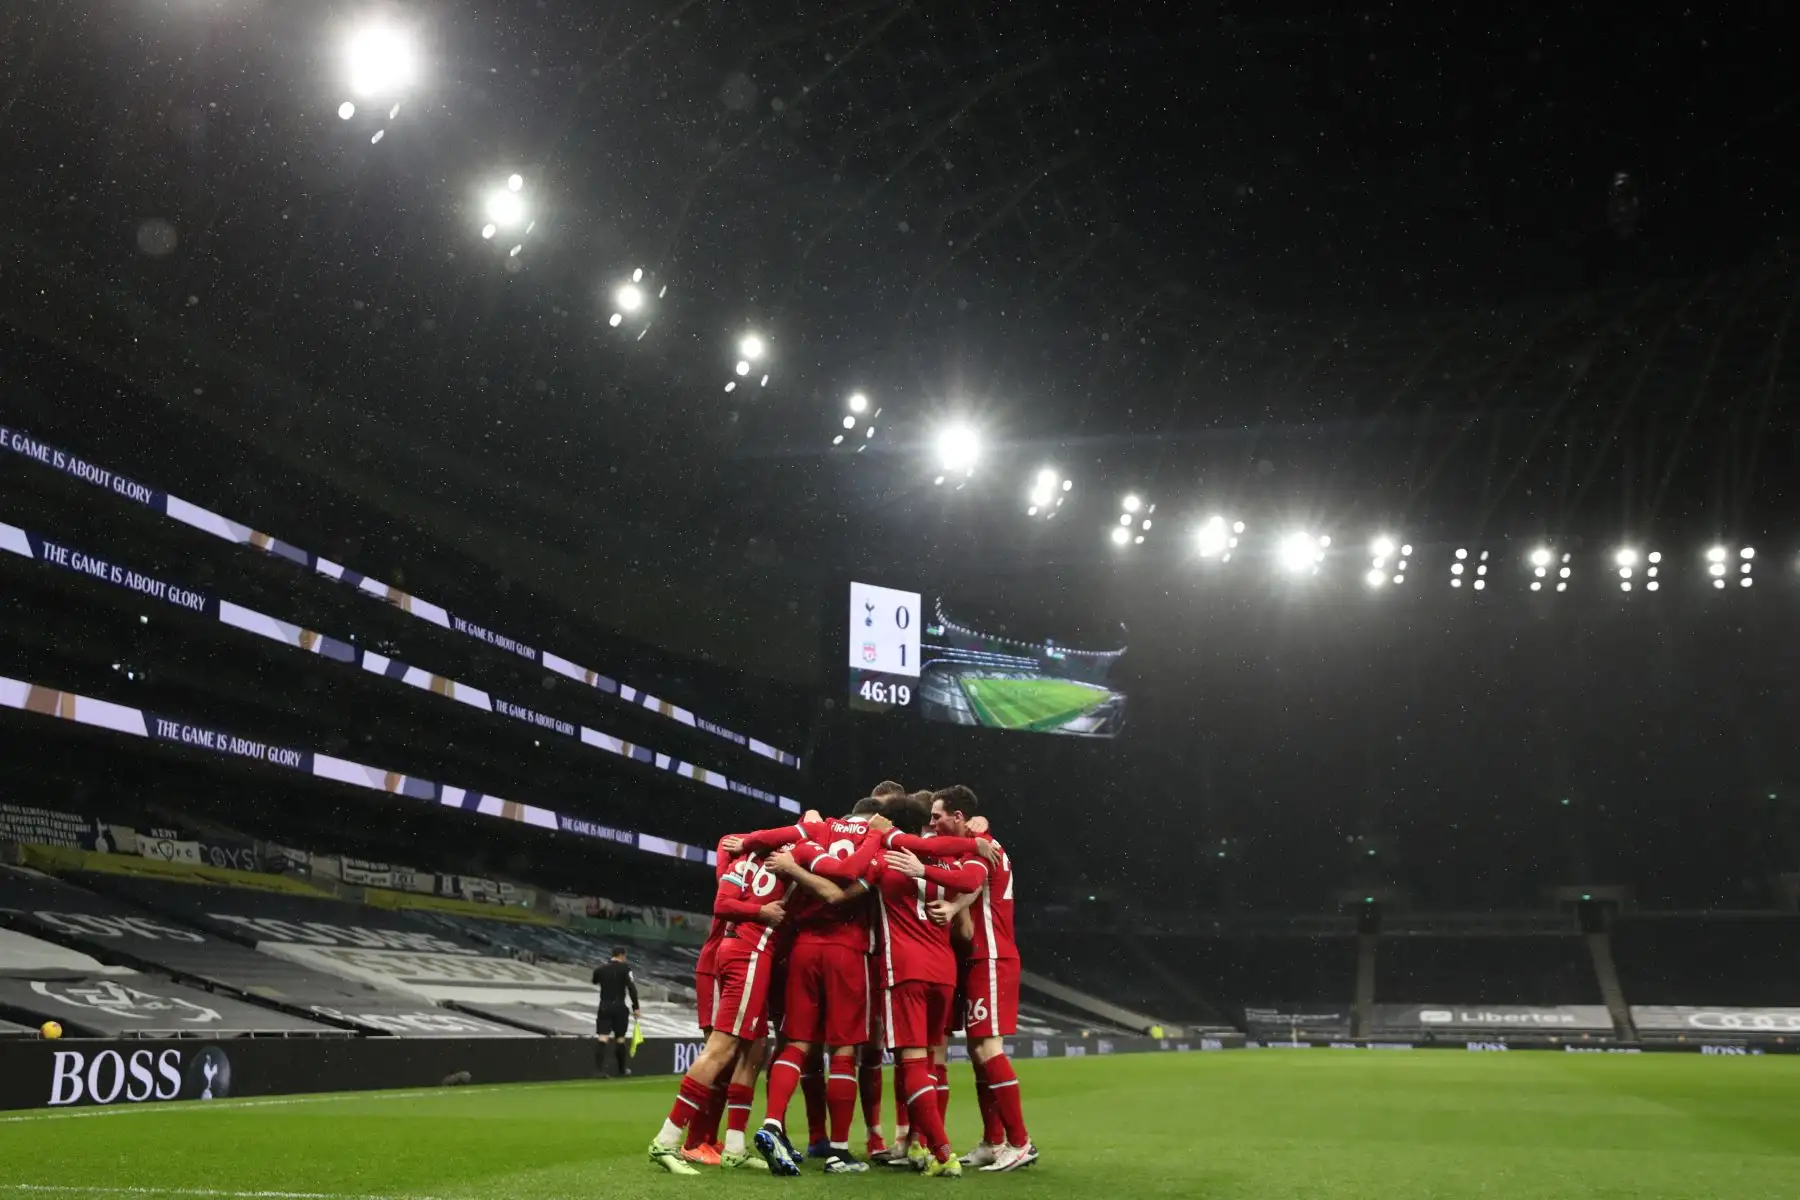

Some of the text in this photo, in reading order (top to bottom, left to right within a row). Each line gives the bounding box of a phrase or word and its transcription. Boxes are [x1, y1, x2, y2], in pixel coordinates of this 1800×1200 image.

[12, 433, 50, 464] GAME
[53, 451, 65, 470] IS
[66, 456, 112, 488] ABOUT
[113, 475, 153, 504] GLORY
[42, 541, 206, 612] THE GAME IS ABOUT GLORY
[454, 616, 468, 633] THE
[468, 620, 486, 641] GAME
[494, 628, 516, 652] ABOUT
[516, 640, 536, 660] GLORY
[896, 606, 910, 630] 0
[899, 644, 906, 667] 1
[860, 680, 910, 706] 46:19
[496, 699, 508, 714] THE
[508, 702, 528, 722] GAME
[534, 710, 555, 729] ABOUT
[555, 716, 574, 736] GLORY
[156, 718, 302, 770] THE GAME IS ABOUT GLORY
[1462, 1011, 1576, 1023] Libertex
[47, 1048, 182, 1106] BOSS
